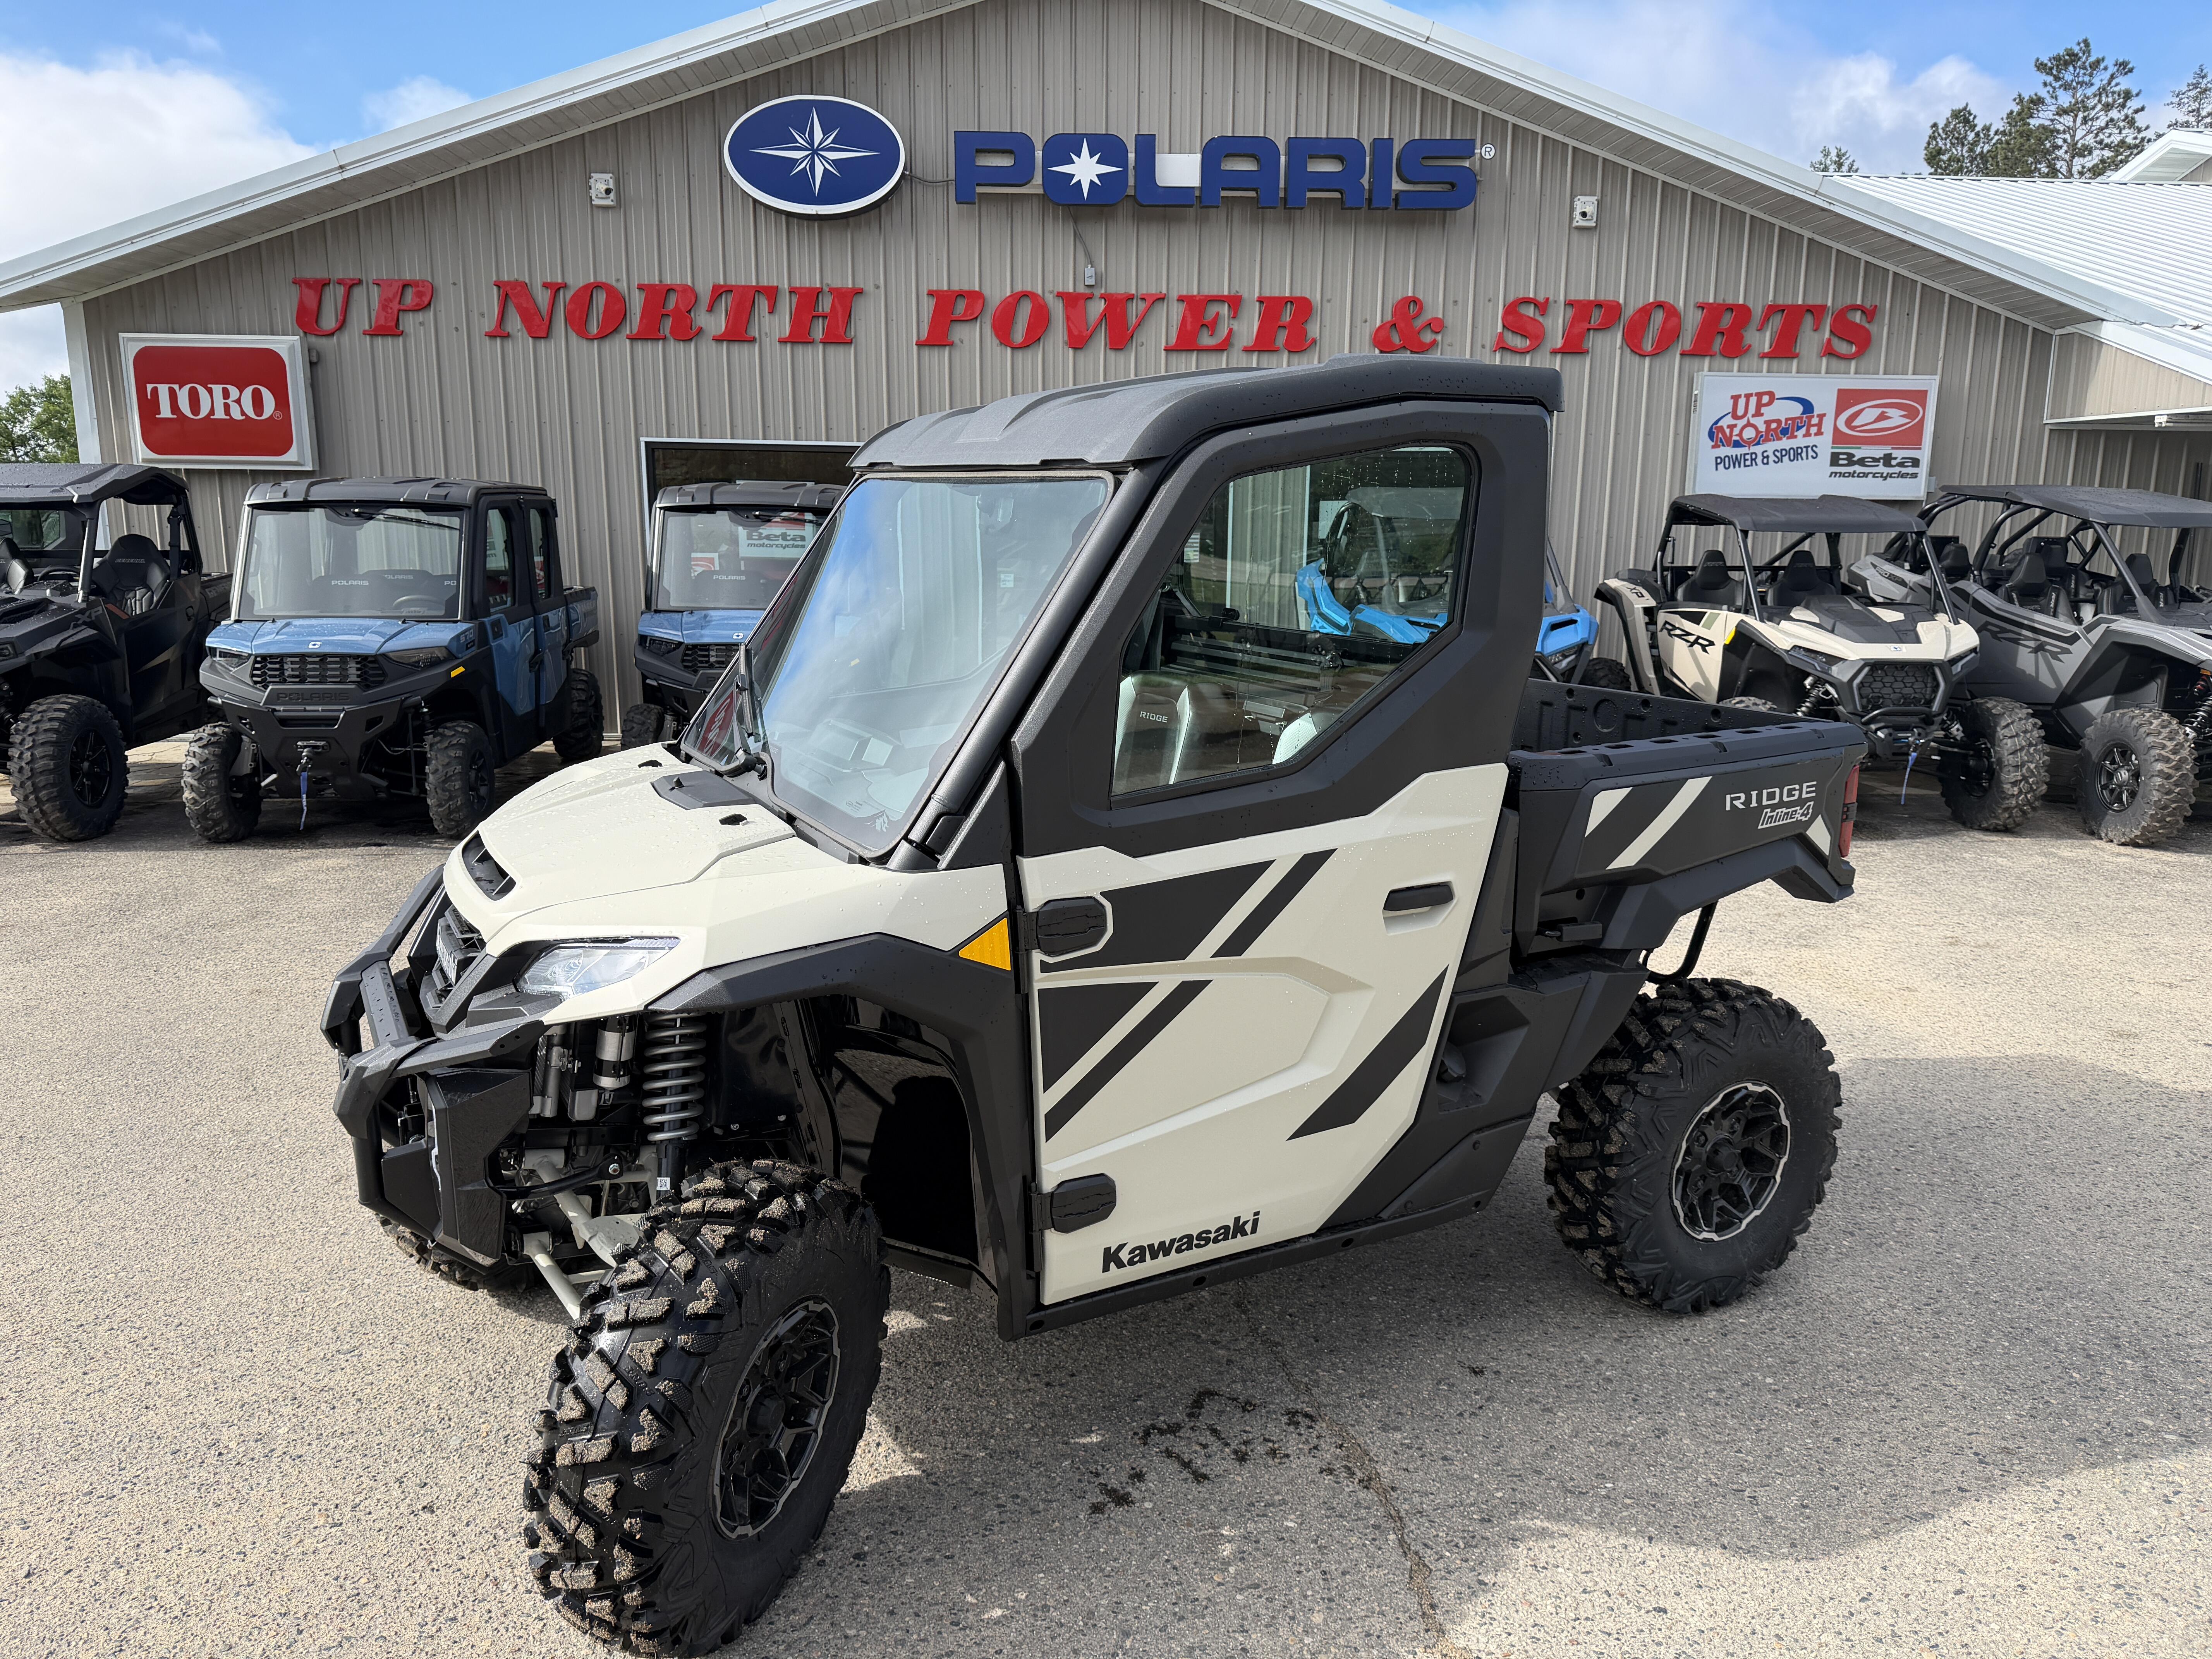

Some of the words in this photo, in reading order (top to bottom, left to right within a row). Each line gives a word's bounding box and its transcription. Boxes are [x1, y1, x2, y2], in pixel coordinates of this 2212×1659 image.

[954, 131, 1477, 211] POLARIS
[291, 277, 433, 336] UP
[484, 280, 864, 344] NORTH
[915, 289, 1317, 352] POWER
[1372, 295, 1444, 353] &
[1493, 296, 1877, 359] SPORTS
[146, 383, 275, 420] TORO
[1730, 390, 1776, 420] UP
[1711, 412, 1827, 450] NORTH
[1715, 452, 1758, 471] POWER
[1761, 450, 1769, 465] &
[1773, 444, 1819, 464] SPORTS
[1830, 452, 1920, 468] Beta
[1829, 469, 1918, 481] motorcycles
[746, 530, 806, 542] Beta
[1626, 587, 1645, 598] XP
[75, 608, 103, 624] XP
[1659, 620, 1716, 654] RZR
[1976, 620, 2073, 663] RZR
[276, 692, 350, 702] POLARIS
[1140, 711, 1168, 723] RIDGE
[1726, 781, 1817, 811] RIDGE
[1758, 801, 1814, 829] Inline-4
[1102, 1211, 1261, 1273] Kawasaki
